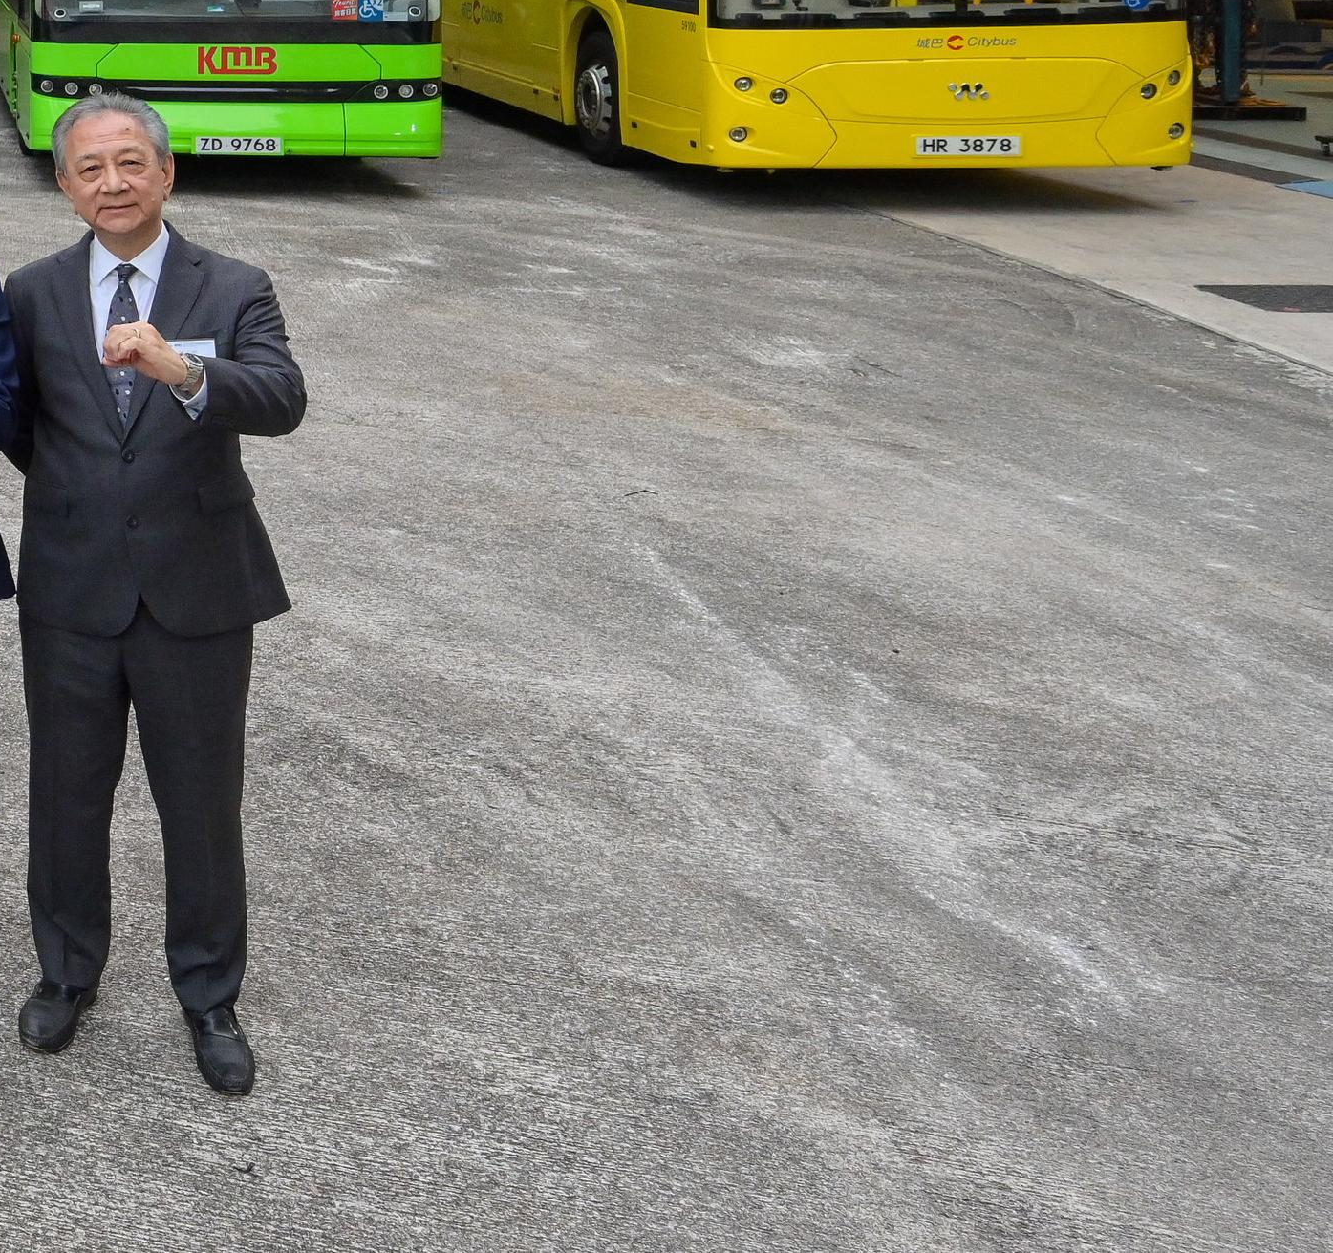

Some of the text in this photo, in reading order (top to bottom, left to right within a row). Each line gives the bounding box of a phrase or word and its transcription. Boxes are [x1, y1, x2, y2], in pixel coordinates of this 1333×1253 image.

[967, 36, 1017, 47] Citybus
[197, 46, 277, 75] KMB
[200, 138, 277, 151] ZD 9768
[922, 138, 1013, 153] HR 3878
